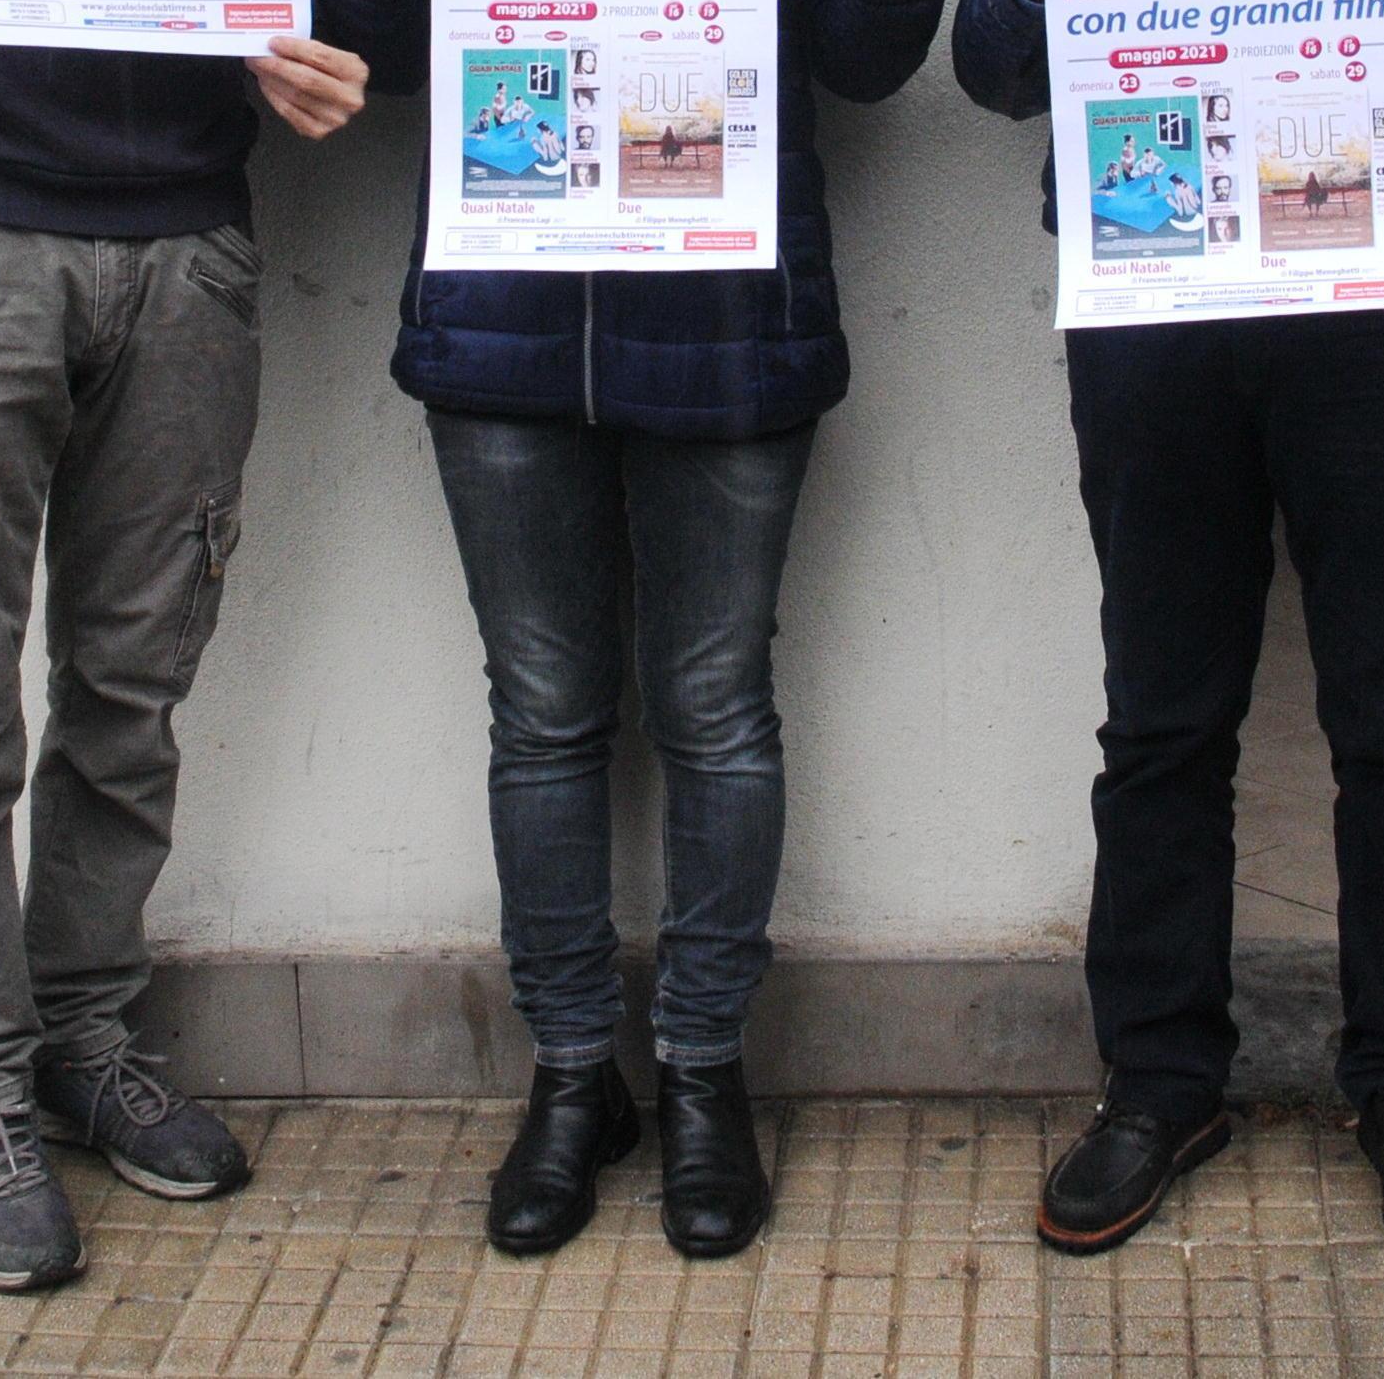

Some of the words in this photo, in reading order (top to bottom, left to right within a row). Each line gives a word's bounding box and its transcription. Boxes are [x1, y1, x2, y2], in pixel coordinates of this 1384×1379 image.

[496, 2, 550, 18] maggio
[553, 2, 588, 15] 2021
[602, 6, 608, 16] 2
[610, 6, 658, 17] PROIEZIONI
[1067, 12, 1126, 36] con
[1136, 1, 1201, 32] due
[449, 30, 490, 40] domenica
[497, 29, 513, 40] 23
[672, 29, 700, 40] sabato
[706, 29, 722, 40] 29
[1118, 48, 1177, 65] maggio
[1179, 45, 1217, 61] 2021
[1233, 47, 1239, 58] 2
[1241, 44, 1295, 58] PROIEZIONI
[1328, 42, 1334, 54] E
[1310, 69, 1341, 80] sabato
[1347, 65, 1364, 77] 29
[639, 73, 703, 112] DUE
[1069, 78, 1114, 93] domenica
[1120, 77, 1138, 90] 23
[1278, 114, 1348, 159] DUE
[461, 202, 493, 215] Quasi
[496, 201, 535, 214] Natale
[618, 202, 642, 214] Due
[1092, 262, 1127, 277] Quasi
[1130, 261, 1172, 275] Natale
[1261, 255, 1287, 268] Due
